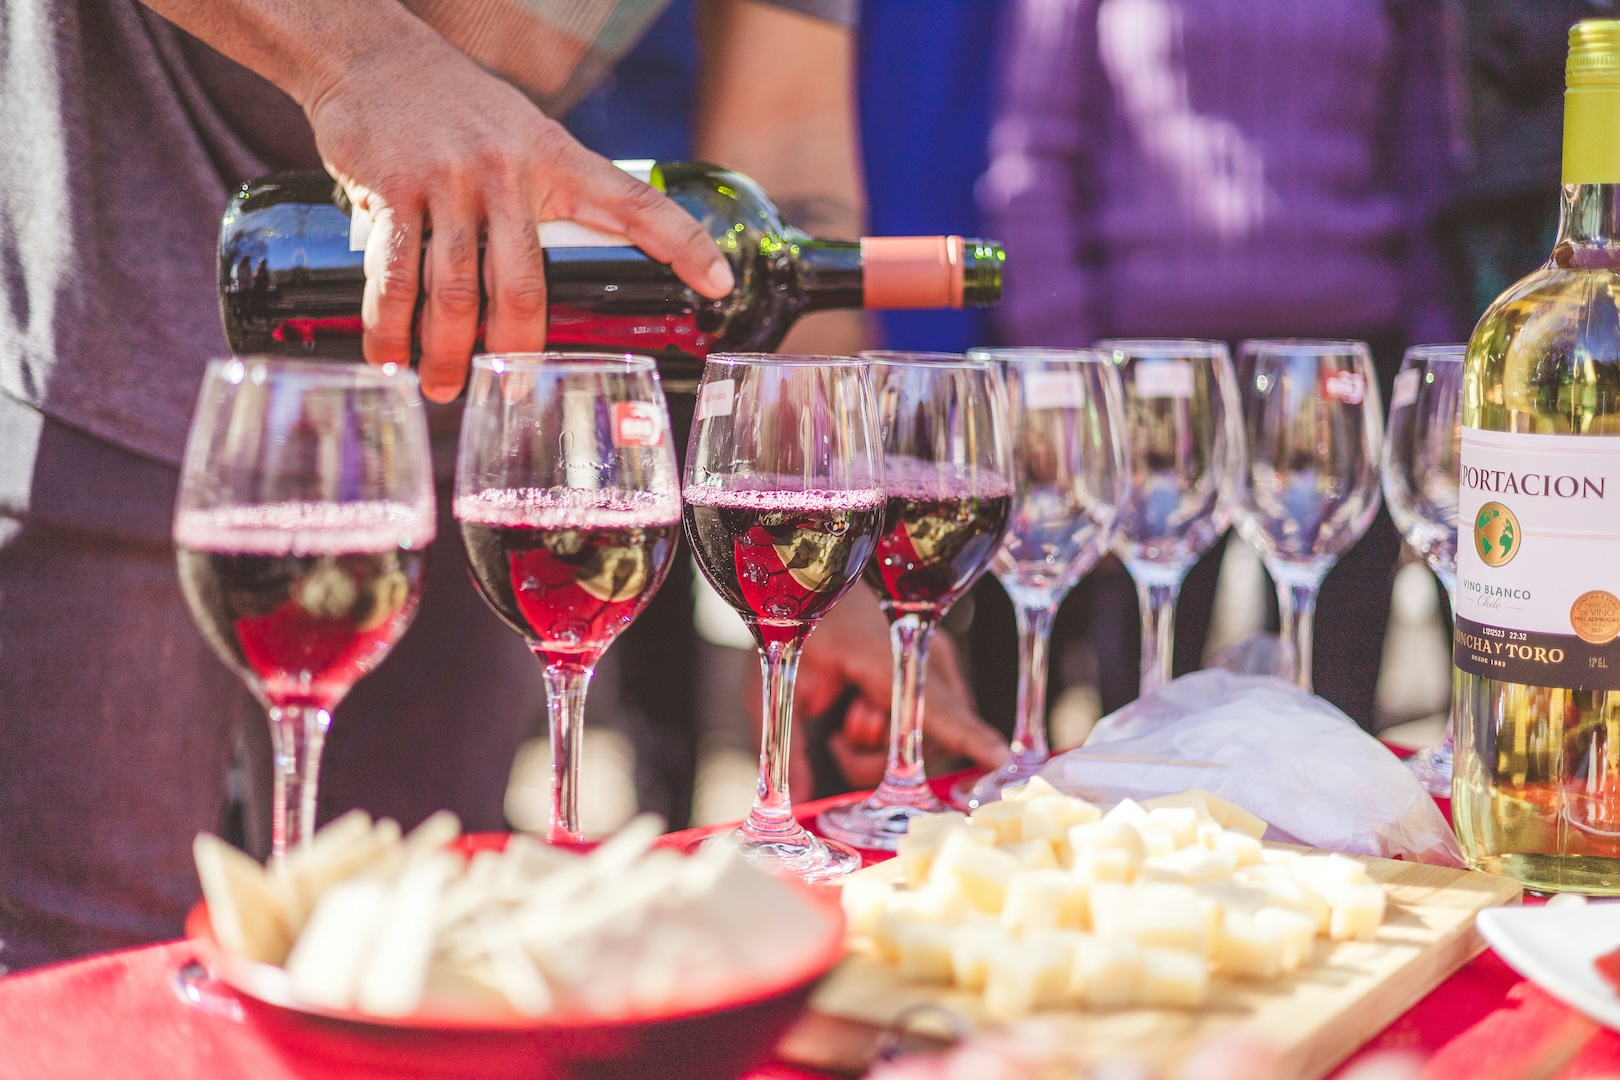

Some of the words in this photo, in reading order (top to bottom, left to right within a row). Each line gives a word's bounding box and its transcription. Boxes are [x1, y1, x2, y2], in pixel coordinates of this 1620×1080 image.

[1460, 463, 1607, 499] PORTACION
[1463, 579, 1481, 593] VINO
[1484, 585, 1531, 600] BLANCO
[1477, 593, 1502, 609] Chile
[1590, 608, 1615, 617] VINO
[1509, 631, 1527, 641] 22:32
[1455, 629, 1492, 654] ONCHA
[1494, 642, 1503, 654] Y
[1505, 643, 1565, 664] TORO
[1471, 654, 1489, 664] DESDE
[1490, 659, 1506, 667] 1883
